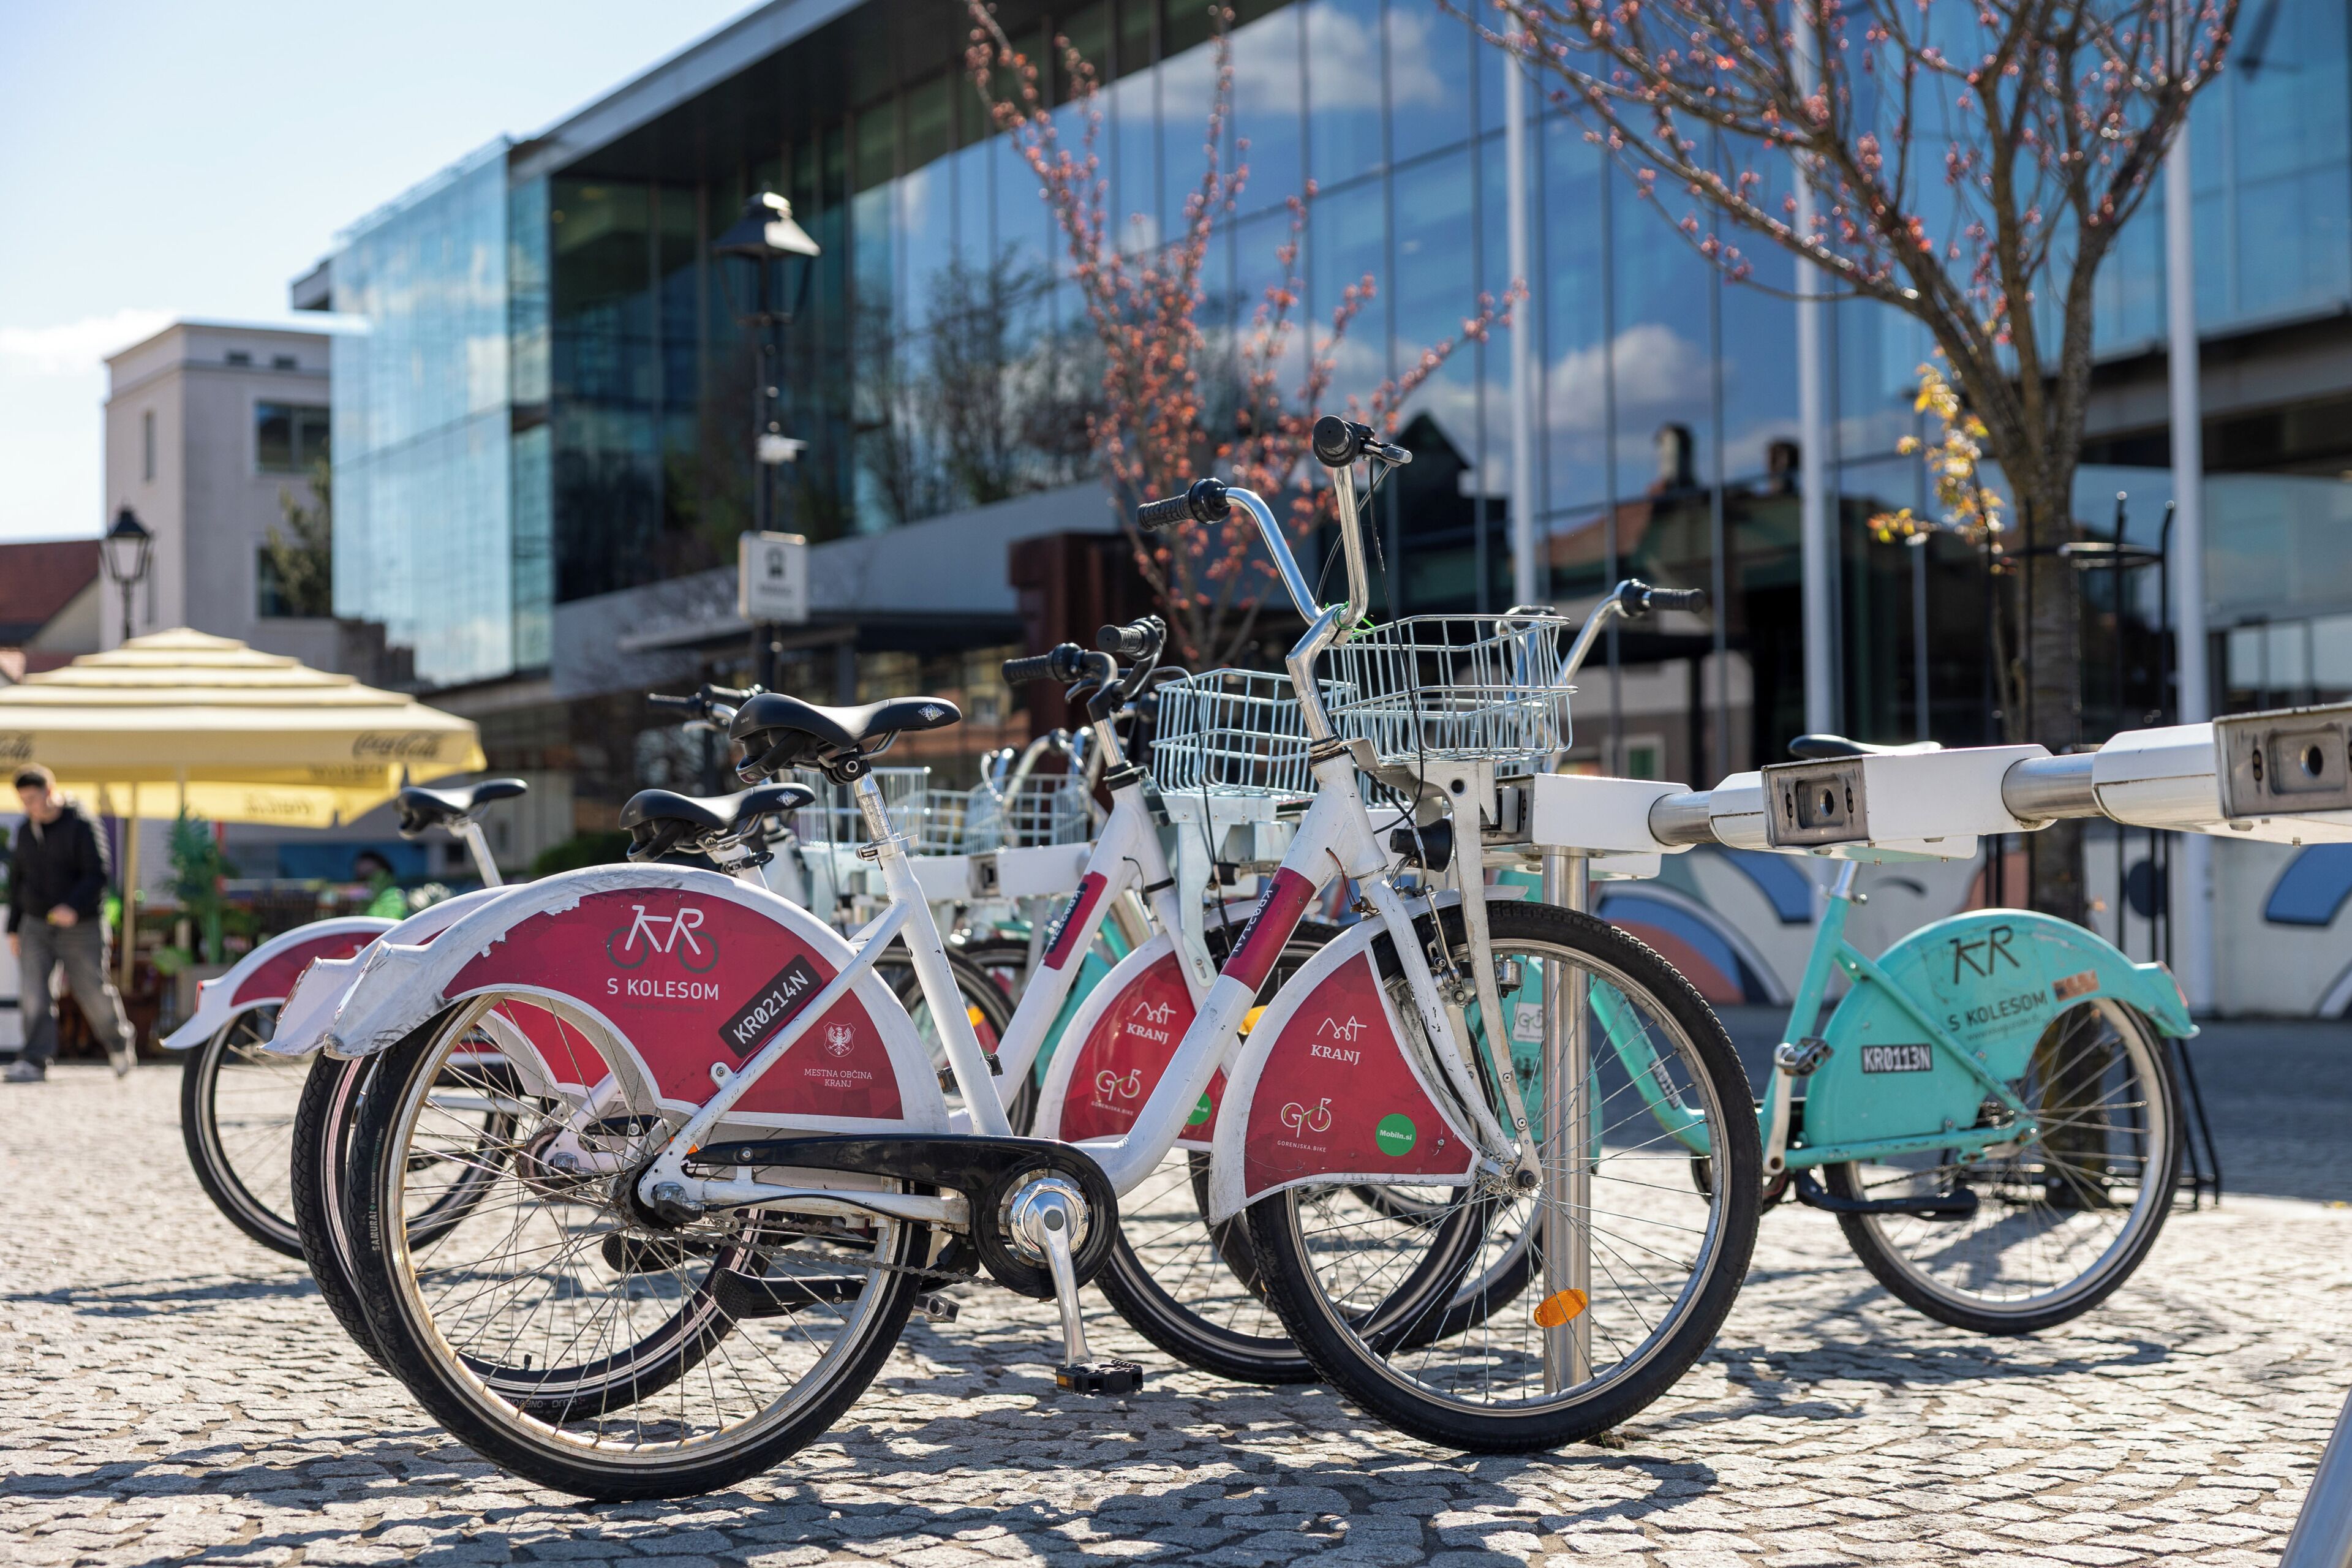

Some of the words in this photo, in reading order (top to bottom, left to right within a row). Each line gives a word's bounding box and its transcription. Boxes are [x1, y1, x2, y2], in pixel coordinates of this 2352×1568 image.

[607, 978, 619, 995] S
[627, 979, 719, 1000] KOLESOM
[733, 970, 809, 1044] KR0214N
[1947, 1014, 1961, 1032] S
[1966, 990, 2049, 1027] KOLESOM
[1126, 1022, 1170, 1045] KRANJ
[1310, 1044, 1361, 1066] KRANJ
[1863, 1046, 1931, 1072] KR0113N
[804, 1068, 838, 1078] MESTNA
[840, 1068, 872, 1080] OBČINA
[824, 1079, 852, 1088] KRANJ
[1277, 1140, 1327, 1153] GORENJSKA.BIKE
[369, 1211, 380, 1251] SAMURAI
